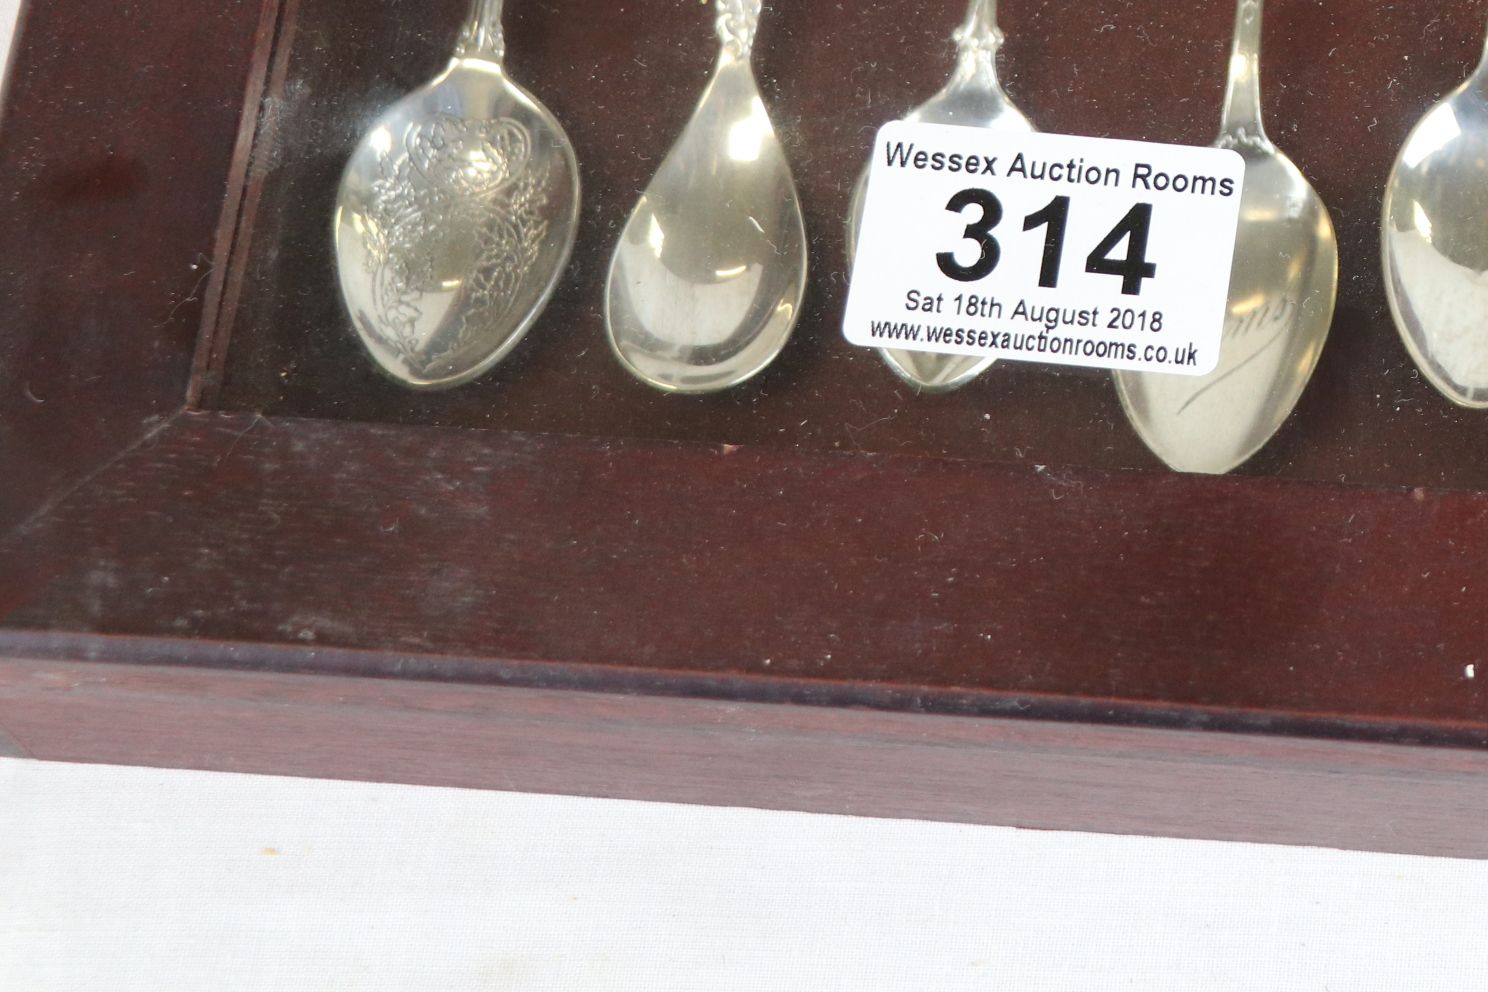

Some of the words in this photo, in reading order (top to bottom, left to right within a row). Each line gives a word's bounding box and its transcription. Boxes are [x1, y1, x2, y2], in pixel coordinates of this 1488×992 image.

[886, 141, 998, 176] Wessex
[1006, 152, 1120, 187] Auction
[1131, 162, 1235, 197] Rooms
[935, 187, 1157, 296] 314
[905, 289, 944, 314] Sat
[953, 293, 1002, 319] 18th
[1010, 299, 1099, 330] August
[1106, 307, 1163, 333] 2018
[870, 320, 1199, 366] www.wessexauctionrooms.co.uk
